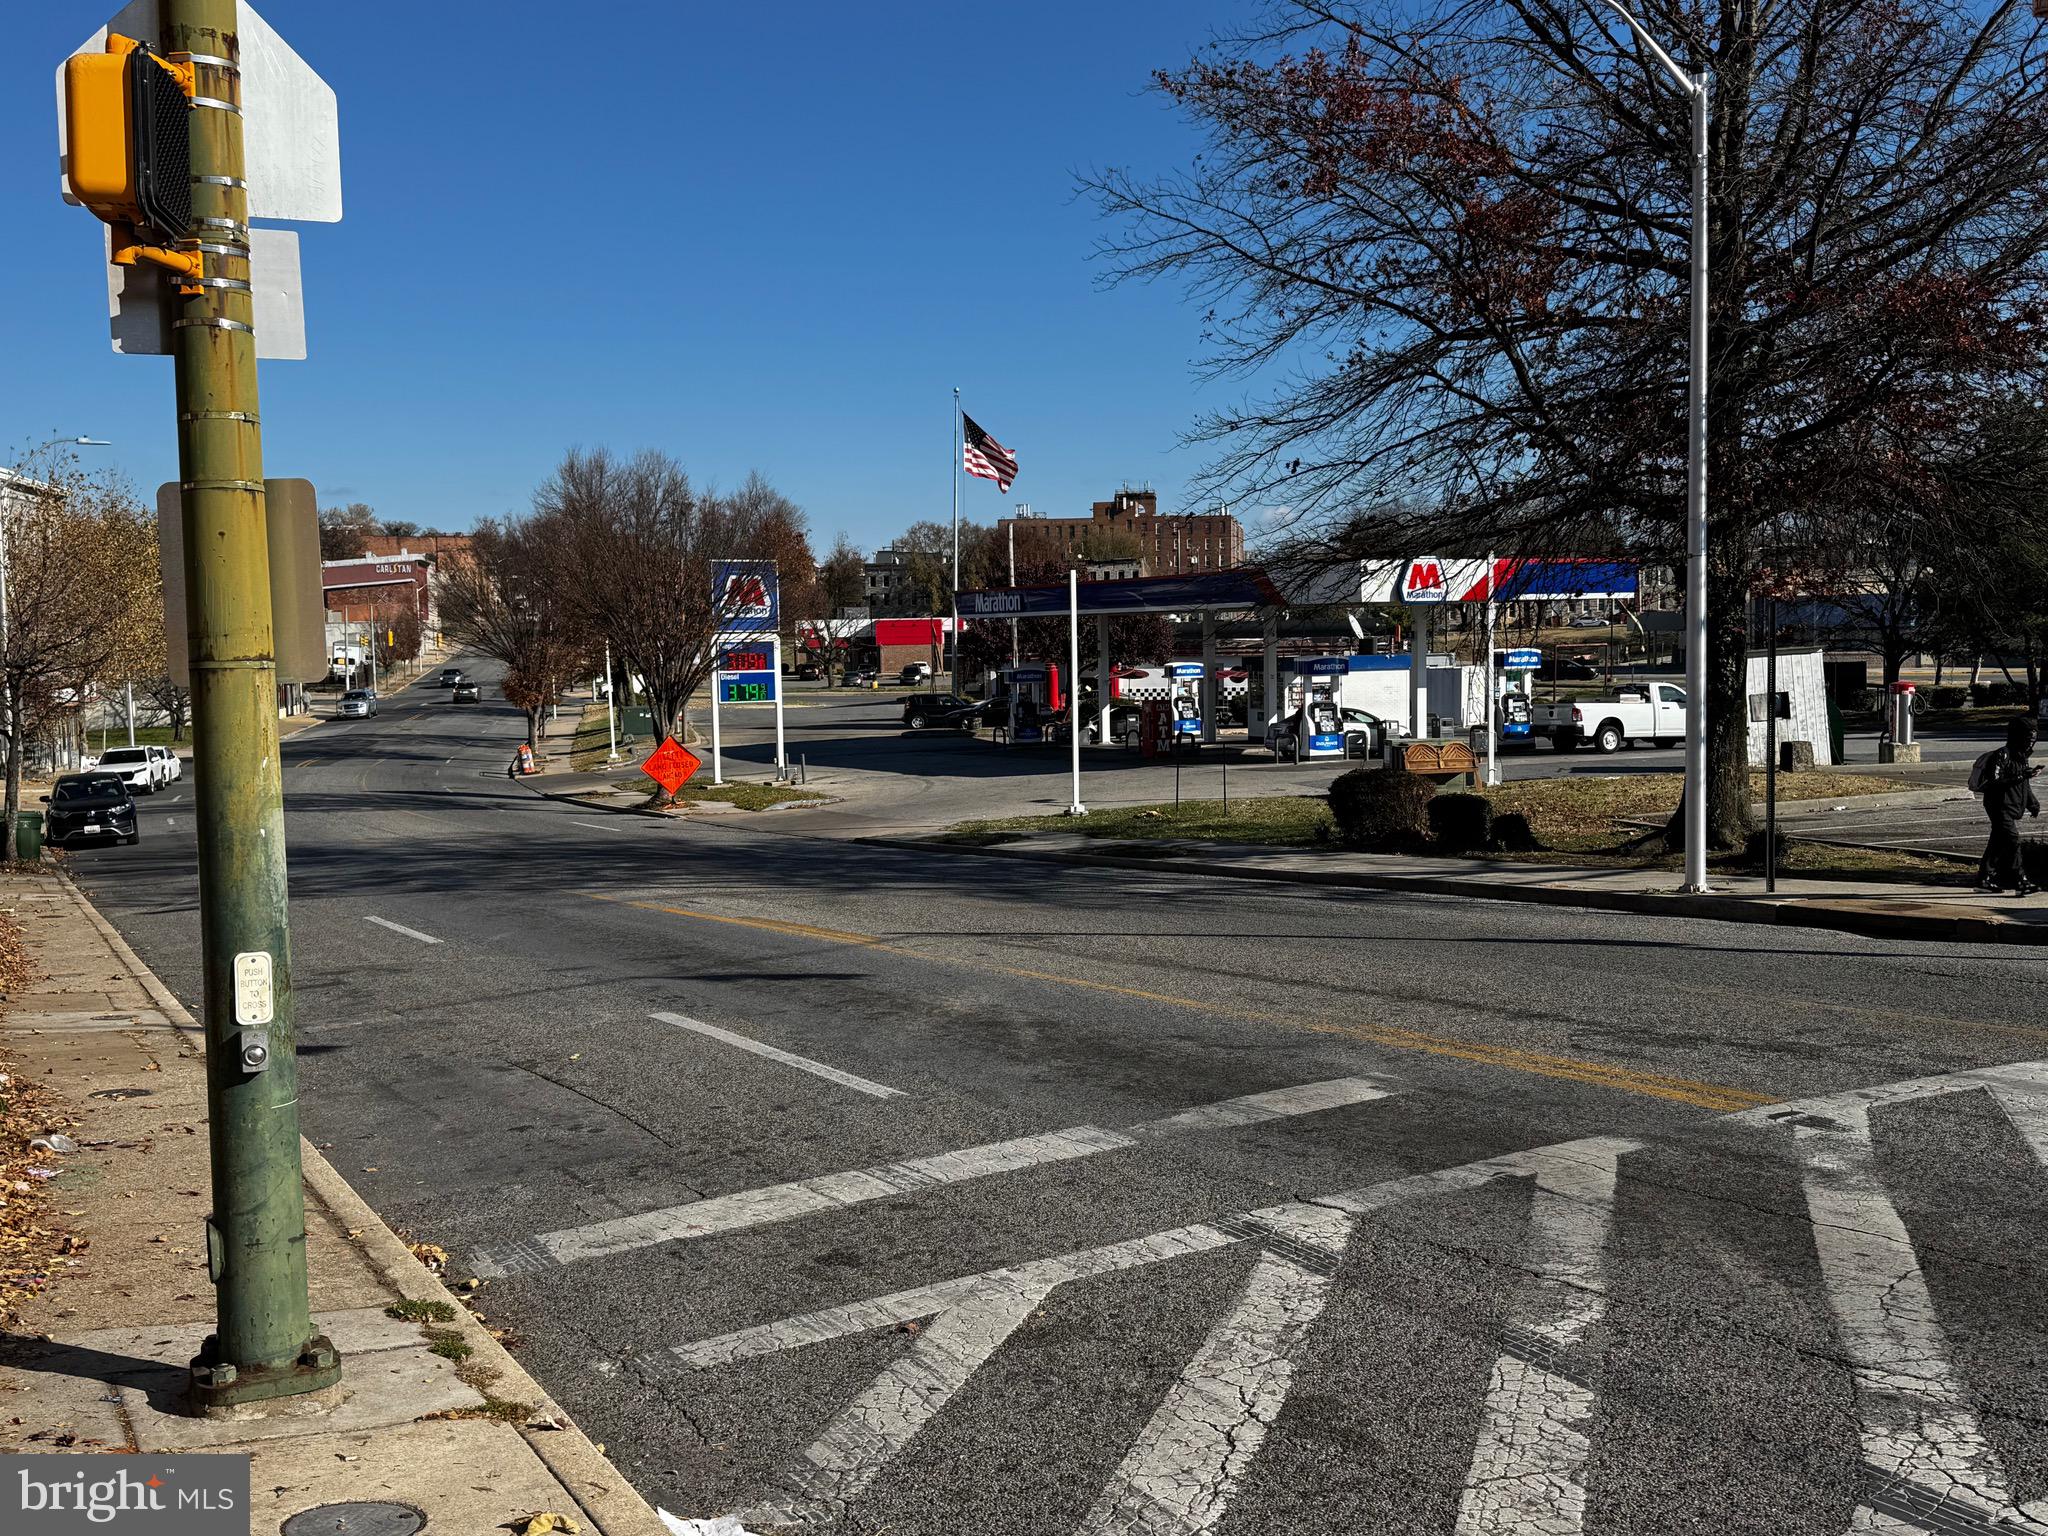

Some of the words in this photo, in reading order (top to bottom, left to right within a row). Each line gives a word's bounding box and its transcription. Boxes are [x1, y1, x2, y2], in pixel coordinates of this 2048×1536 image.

[375, 563, 412, 574] CARLSTAN
[1407, 563, 1441, 590] M
[1406, 590, 1443, 599] Marathon
[975, 593, 1021, 612] Marathon
[1313, 663, 1345, 671] Marathon
[720, 673, 740, 681] Diesel
[244, 968, 263, 977] PUSH
[240, 979, 268, 988] BUTTON
[249, 990, 260, 998] TO
[242, 1001, 267, 1010] CROSS
